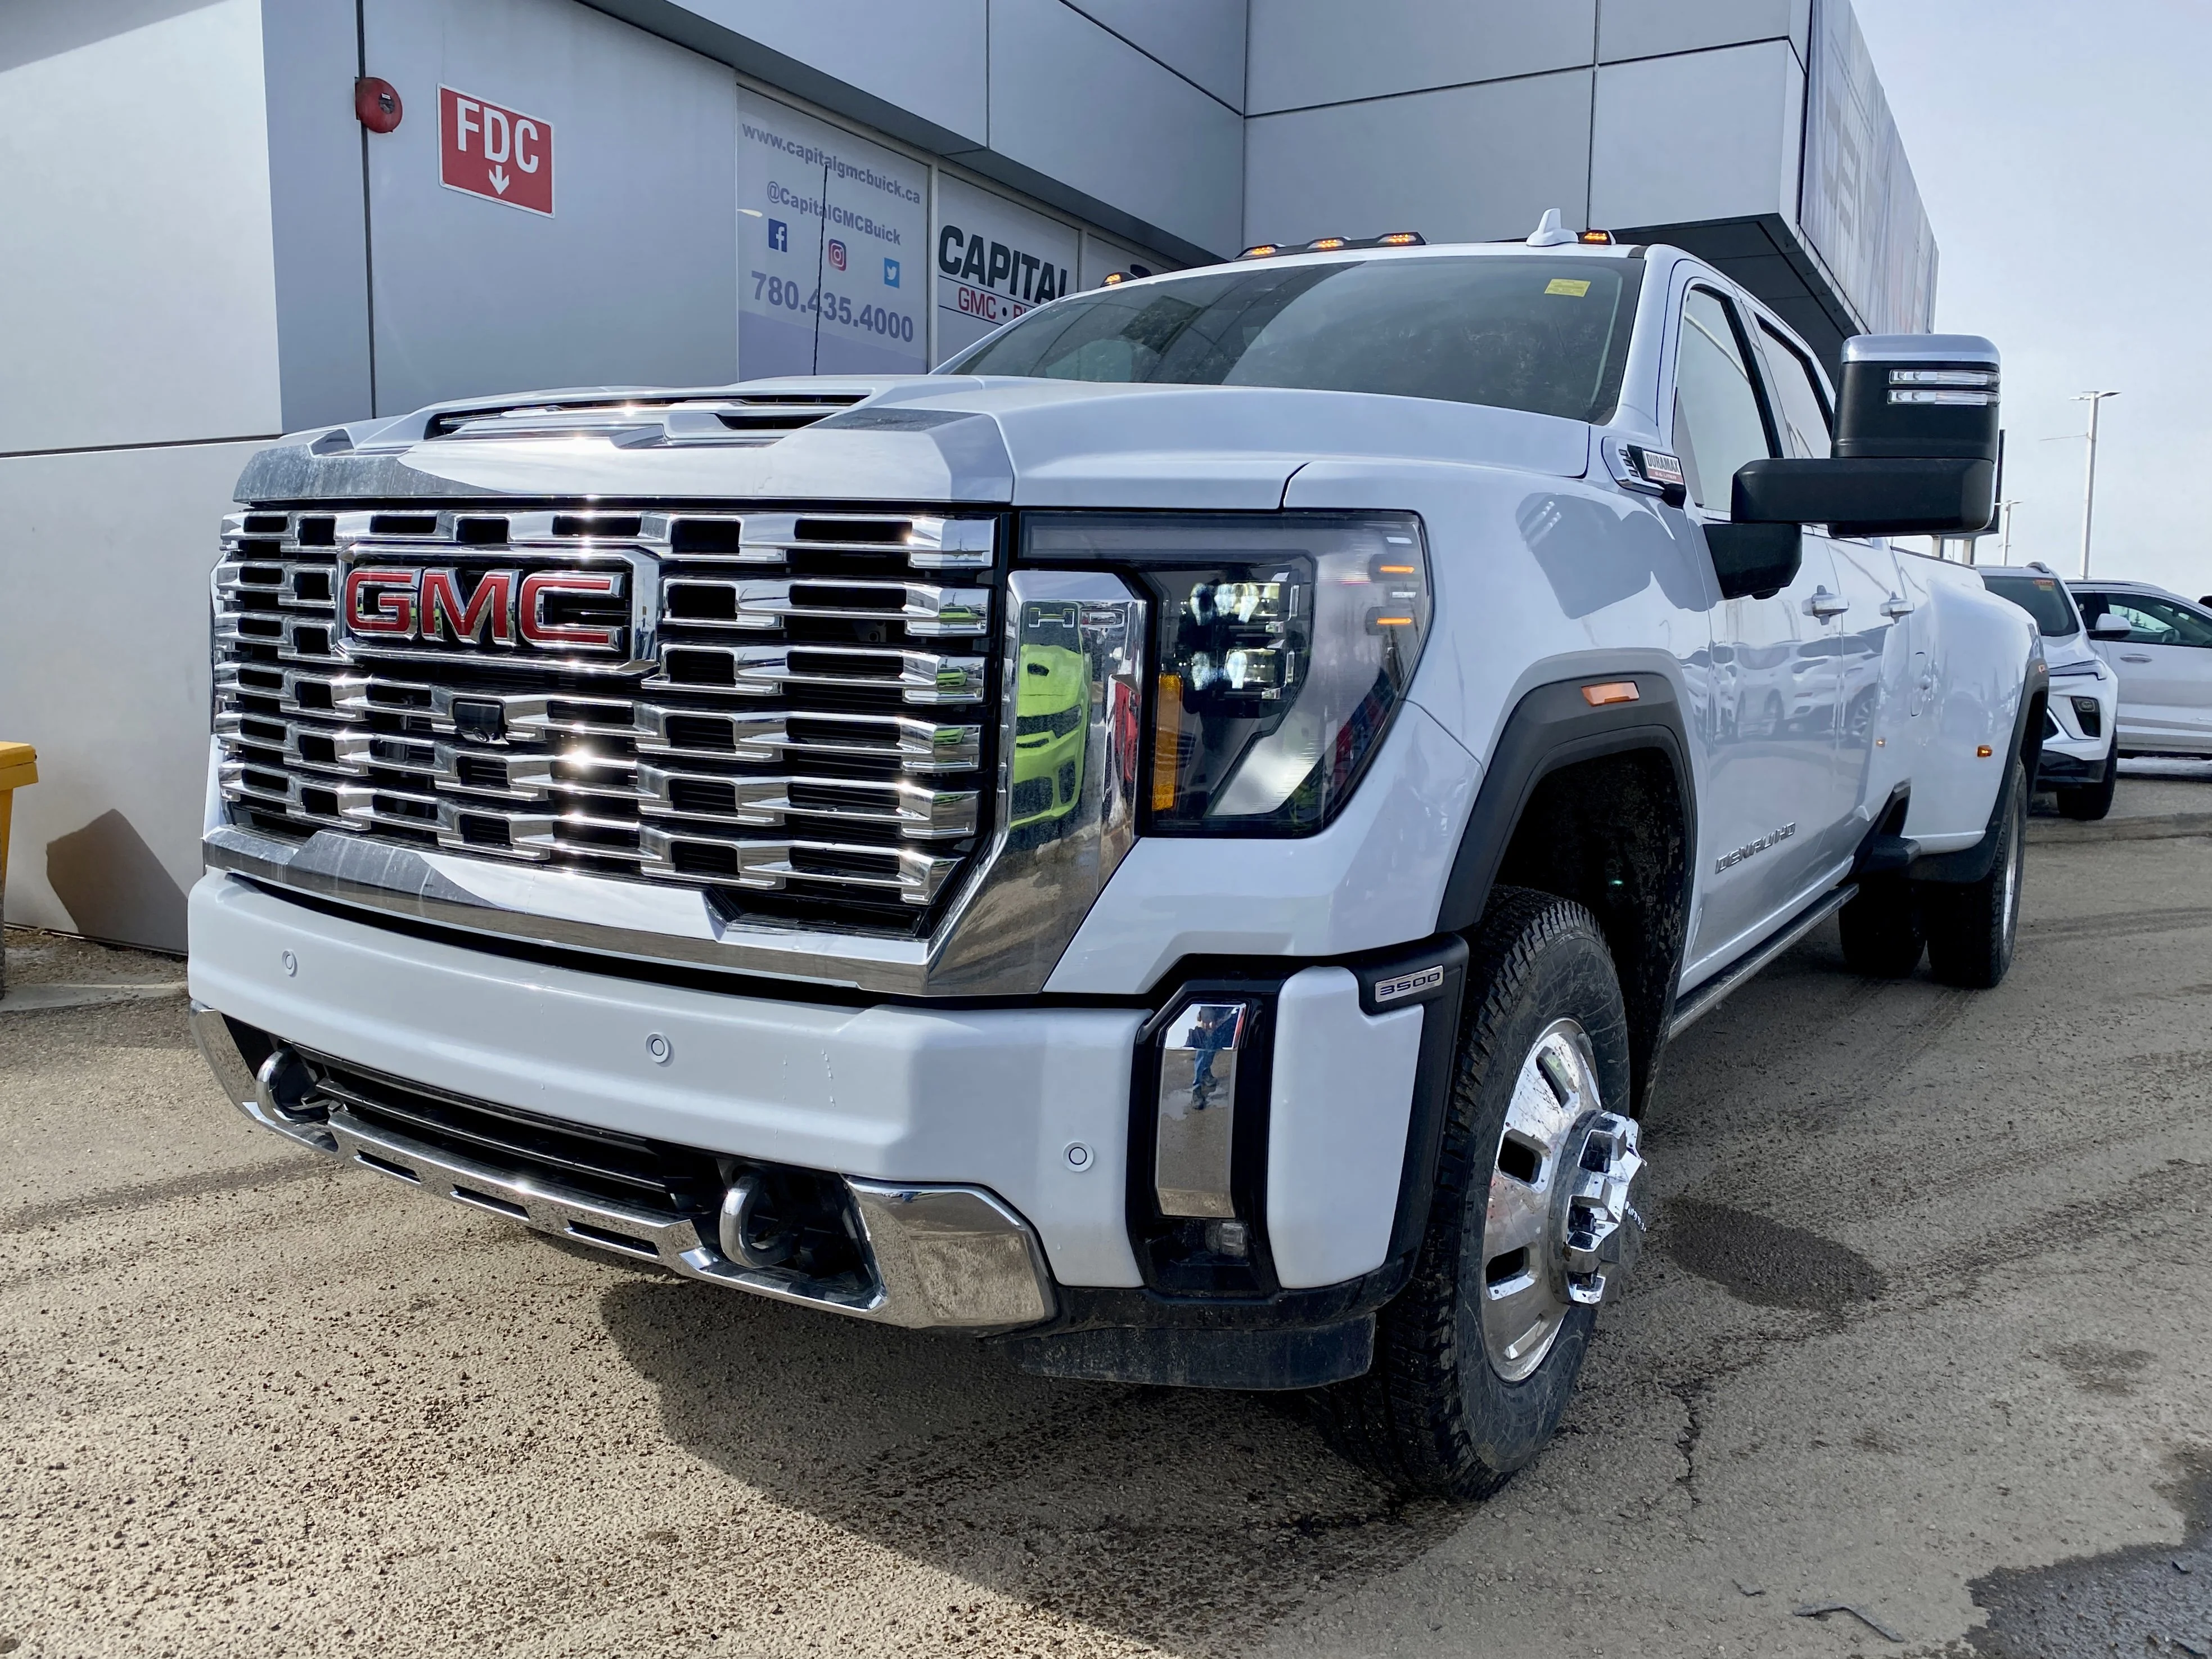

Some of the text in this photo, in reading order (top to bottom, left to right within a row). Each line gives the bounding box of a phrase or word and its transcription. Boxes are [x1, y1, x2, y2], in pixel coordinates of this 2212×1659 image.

[457, 97, 538, 173] FDC
[742, 123, 921, 204] www.capitalgmcbuick.ca
[767, 181, 901, 245] @CapitalGMCBuick
[751, 270, 913, 343] 780.435.4000
[958, 287, 997, 320] GMC
[1646, 453, 1680, 473] DURAMAX
[344, 565, 624, 653] GMC
[1380, 972, 1440, 996] 3500
